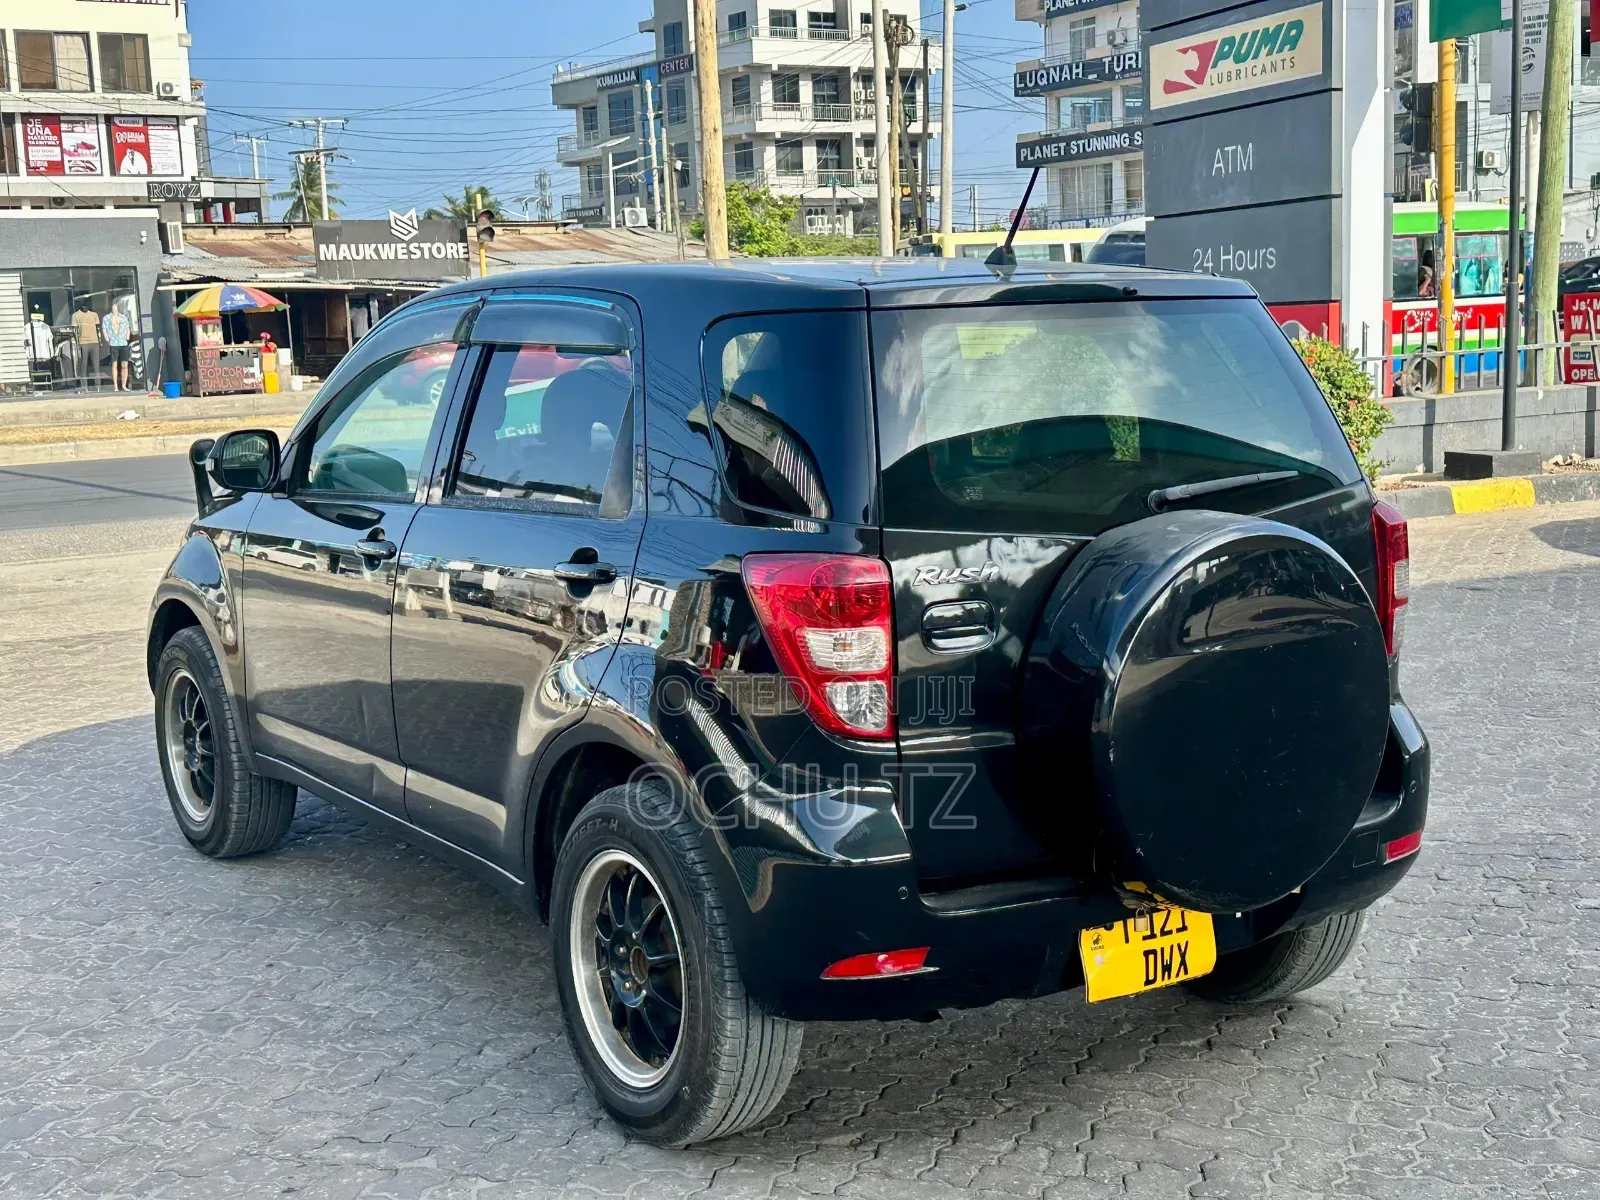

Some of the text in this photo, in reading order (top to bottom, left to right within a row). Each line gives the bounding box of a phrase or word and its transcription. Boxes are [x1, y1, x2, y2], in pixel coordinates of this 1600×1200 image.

[1211, 19, 1304, 68] PUMA
[660, 58, 690, 73] CENTER
[1016, 62, 1083, 88] LUQNAH
[1209, 56, 1297, 86] LUBRICANTS
[596, 70, 637, 88] KUMALIJA
[27, 127, 52, 136] UNA
[1020, 142, 1067, 162] PLANET
[1070, 133, 1130, 155] STUNNING
[1212, 142, 1254, 177] ATM
[149, 182, 201, 198] ROYZ
[1193, 244, 1277, 273] 24 Hours
[1571, 368, 1597, 381] OPE
[914, 561, 1000, 587] Rush
[1143, 940, 1189, 987] DWX
